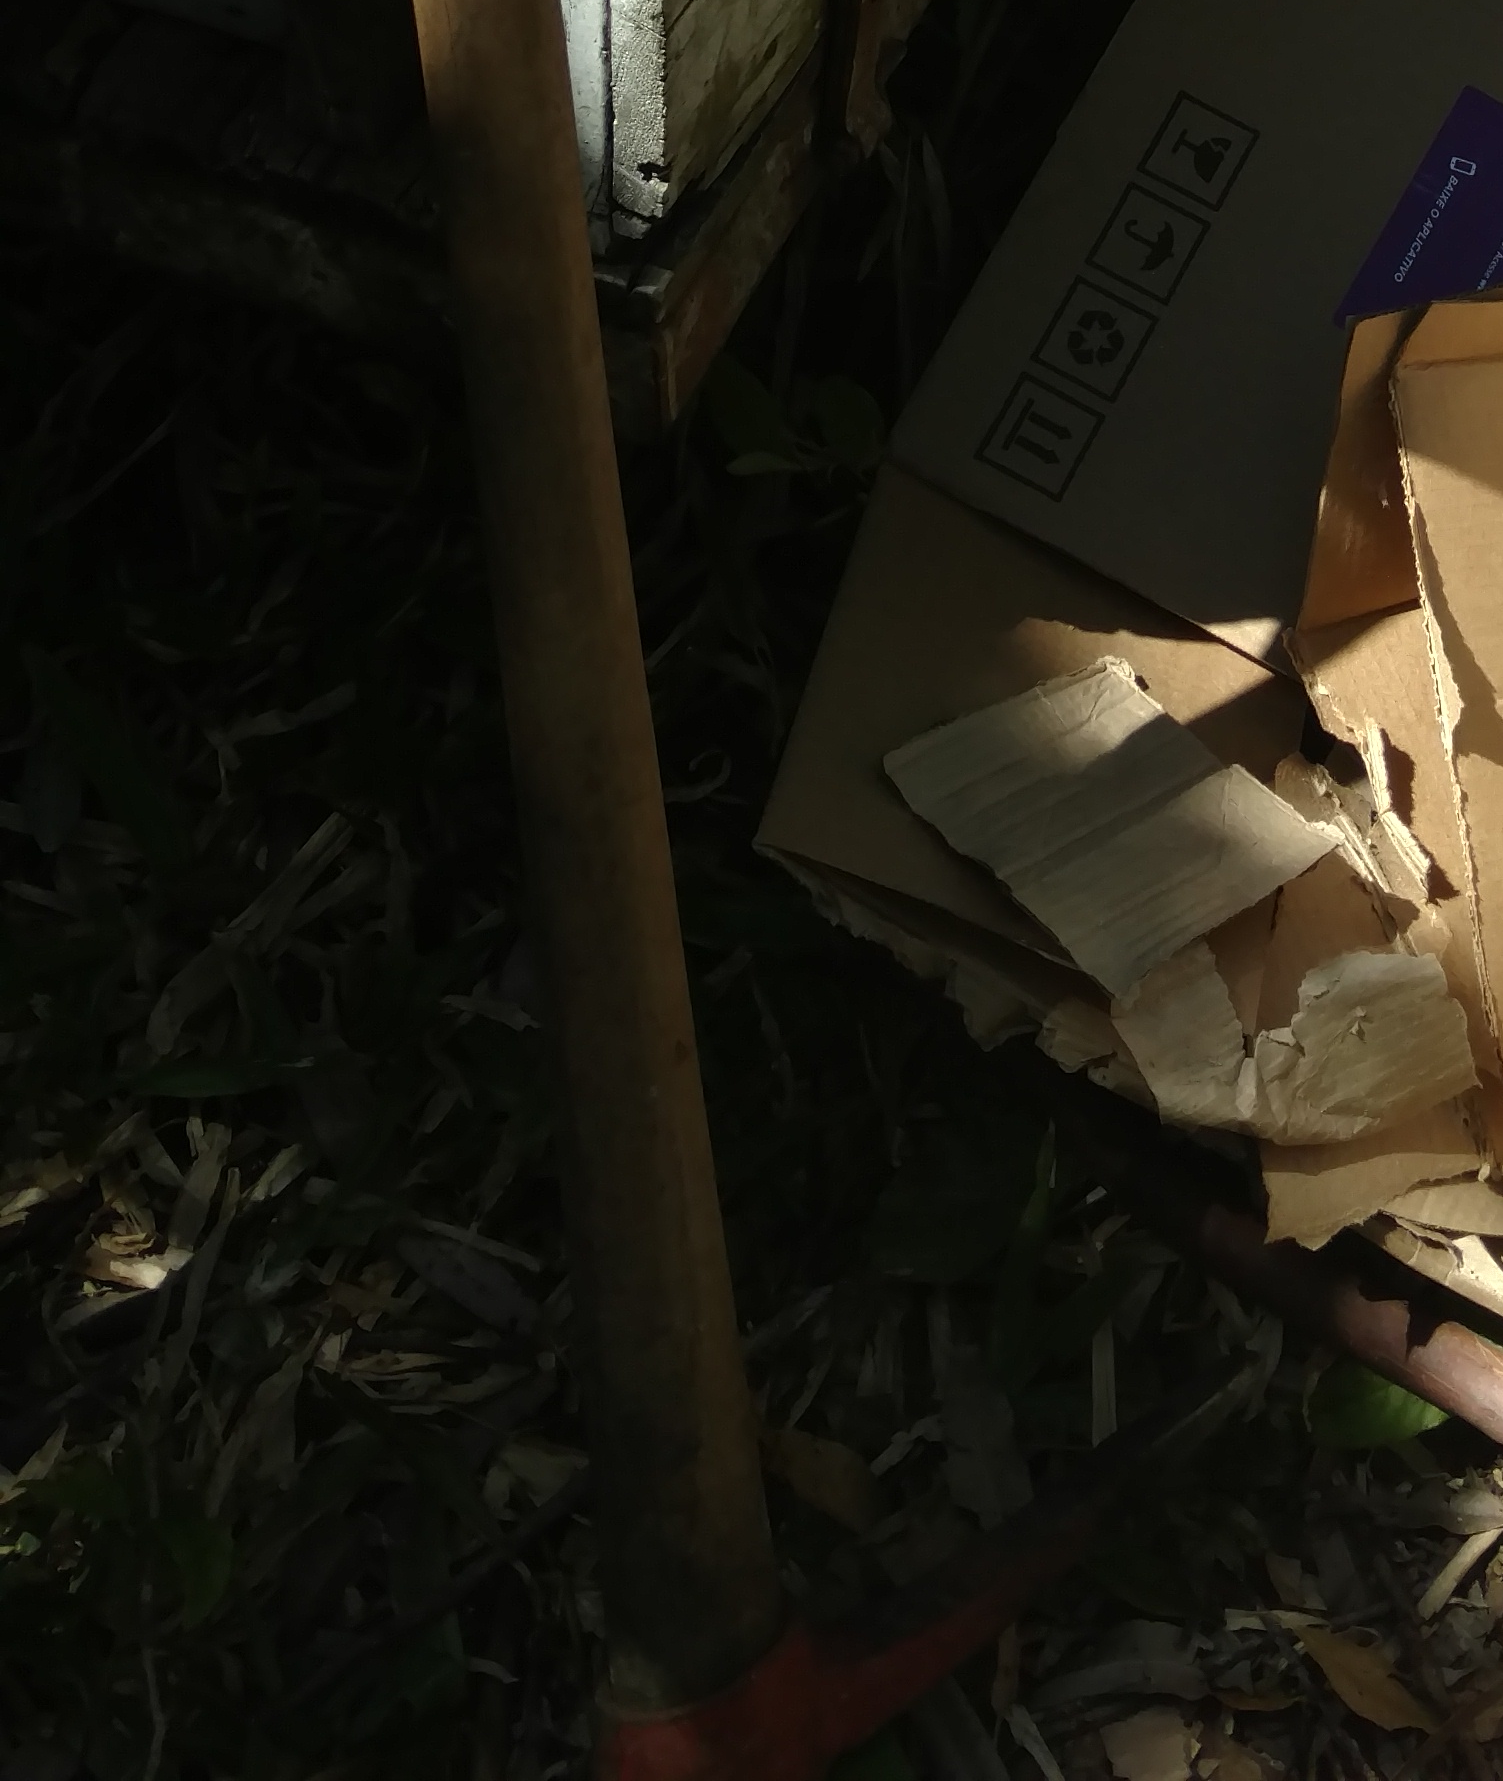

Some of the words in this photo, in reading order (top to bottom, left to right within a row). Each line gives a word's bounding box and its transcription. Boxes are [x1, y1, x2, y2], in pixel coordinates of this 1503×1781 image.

[1436, 174, 1459, 209] BAIXE
[1429, 208, 1440, 219] O
[1394, 217, 1434, 283] APLICATIVO
